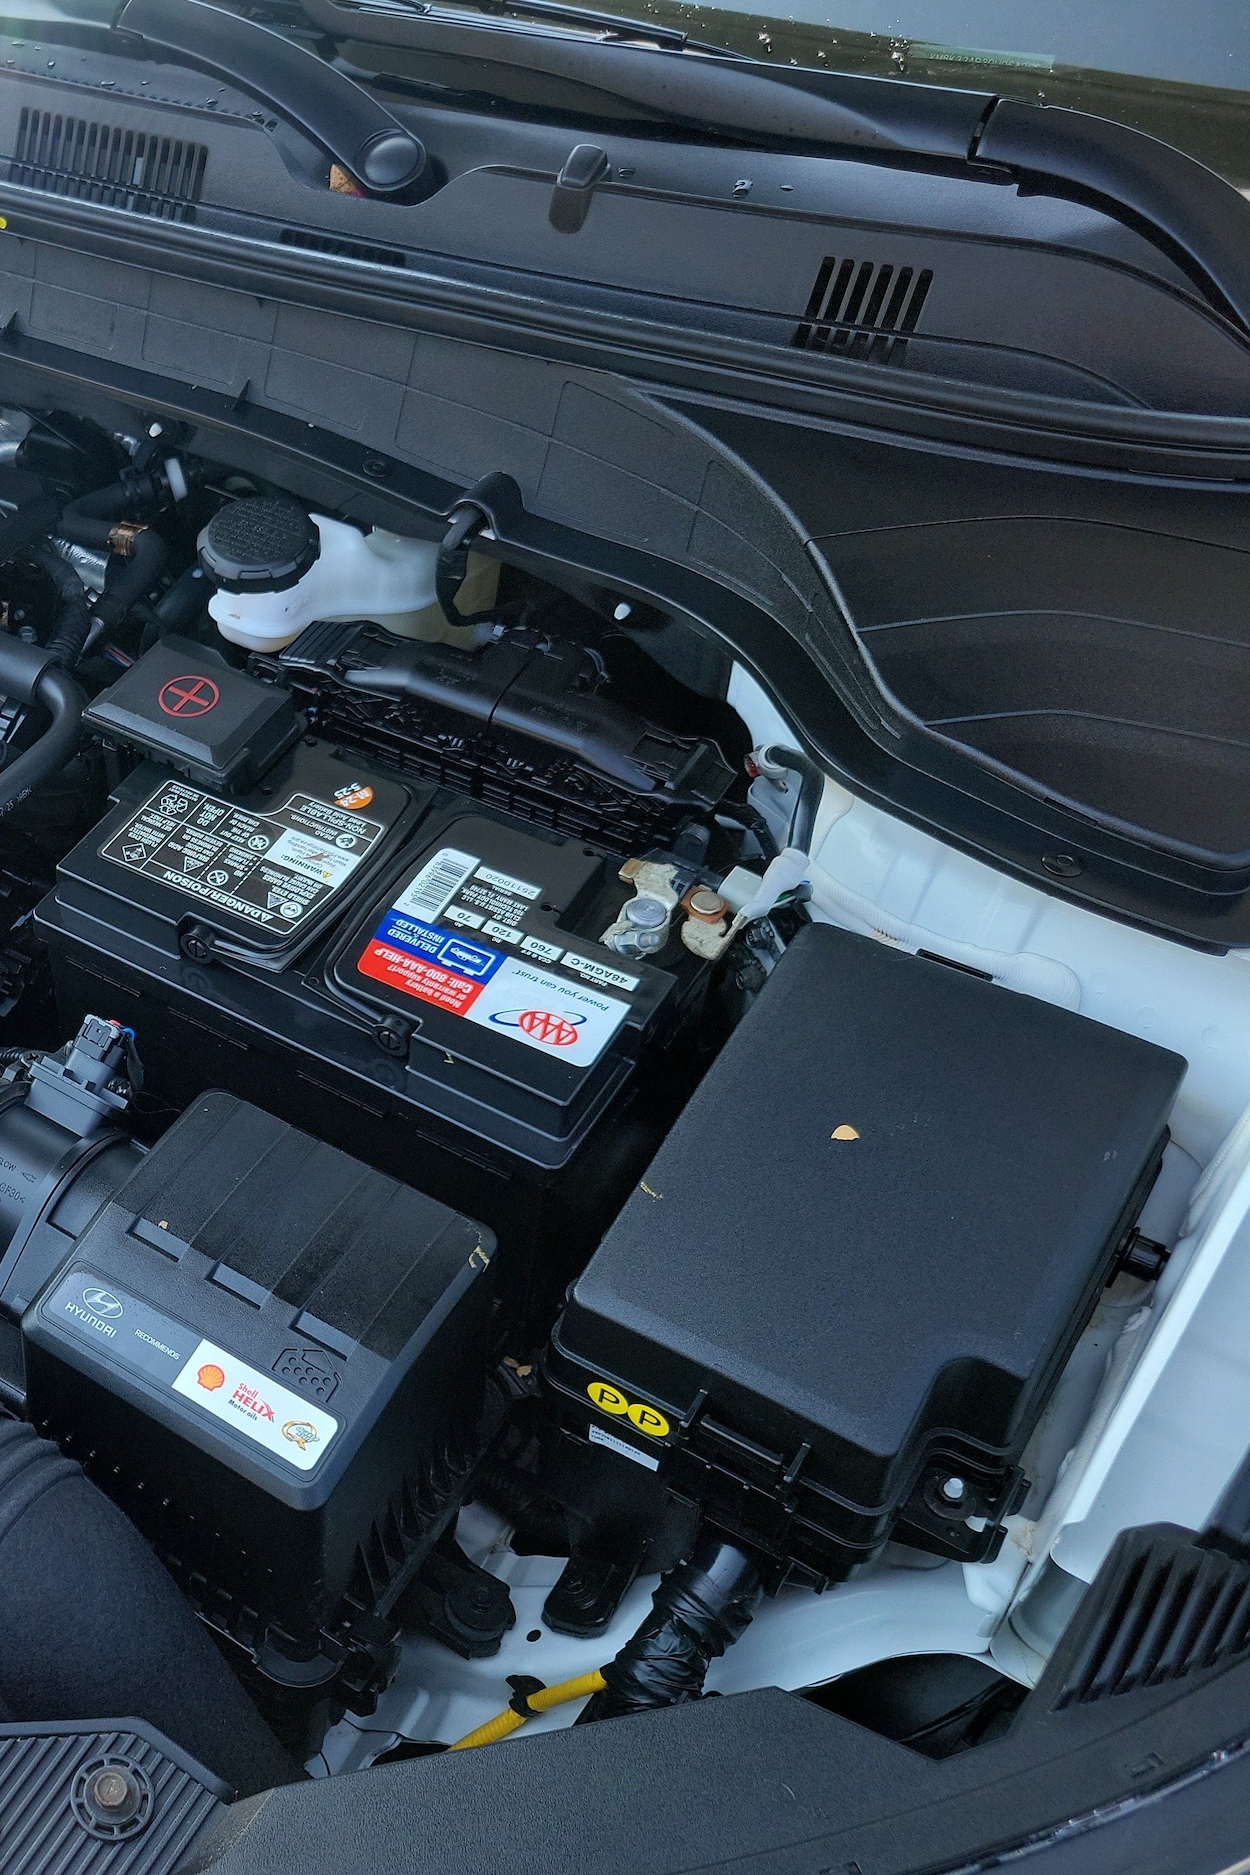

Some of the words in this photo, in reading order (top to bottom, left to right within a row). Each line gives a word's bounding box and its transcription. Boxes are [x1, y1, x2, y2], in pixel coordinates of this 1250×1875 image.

[333, 782, 362, 799] 5-25
[200, 802, 225, 815] OPEN.
[307, 801, 334, 814] Battery
[139, 815, 162, 827] MEDICAL
[196, 817, 210, 826] DO
[199, 810, 217, 820] NOT
[299, 805, 366, 834] NON-SPILLABLE
[332, 811, 349, 820] Acid
[348, 817, 366, 826] Lead
[236, 822, 255, 831] REACH
[202, 836, 223, 846] SEVERE
[230, 834, 246, 843] KEEP
[314, 830, 333, 840] READ
[167, 842, 183, 850] ACID
[185, 842, 203, 851] CAUSE
[190, 837, 219, 851] BLINDNESS
[181, 847, 210, 862] SULFURIC
[227, 853, 250, 864] FLAMES
[223, 858, 245, 869] SPARKS
[280, 854, 323, 874] WARNING:
[259, 866, 291, 881] BLINDNESS
[262, 874, 285, 886] GASES
[288, 878, 309, 889] CAUSE
[485, 873, 535, 895] 25110020
[491, 885, 511, 895] SERIAL
[162, 870, 263, 917] DANGER/POISON
[283, 883, 315, 899] EXPLOSIVE
[287, 893, 310, 905] SHIELD
[485, 904, 505, 915] ASSIST
[512, 902, 528, 911] LAKE
[457, 911, 472, 921] 70
[505, 912, 520, 920] CLUB
[395, 918, 445, 943] INSTALLED
[491, 925, 513, 938] 120
[387, 928, 437, 953] DELIVERED
[530, 941, 553, 955] 760
[373, 946, 448, 982] 800-AAA-HELP
[387, 963, 422, 982] support?
[569, 957, 628, 985] 48AGM-C
[405, 979, 434, 996] battery
[422, 977, 457, 996] warranty
[447, 977, 473, 993] Call:
[539, 979, 557, 989] can
[591, 977, 607, 986] PART
[564, 988, 582, 999] you
[442, 995, 462, 1008] Need
[581, 996, 609, 1011] Power
[521, 1011, 576, 1045] AAA
[64, 1301, 118, 1339] HYUNDAI
[134, 1328, 181, 1361] RECOMMENDS
[238, 1382, 260, 1399] Shell
[227, 1398, 248, 1417] Motor
[247, 1409, 259, 1422] oils
[231, 1391, 276, 1423] HELIX
[598, 1388, 620, 1404] P
[638, 1409, 661, 1426] P
